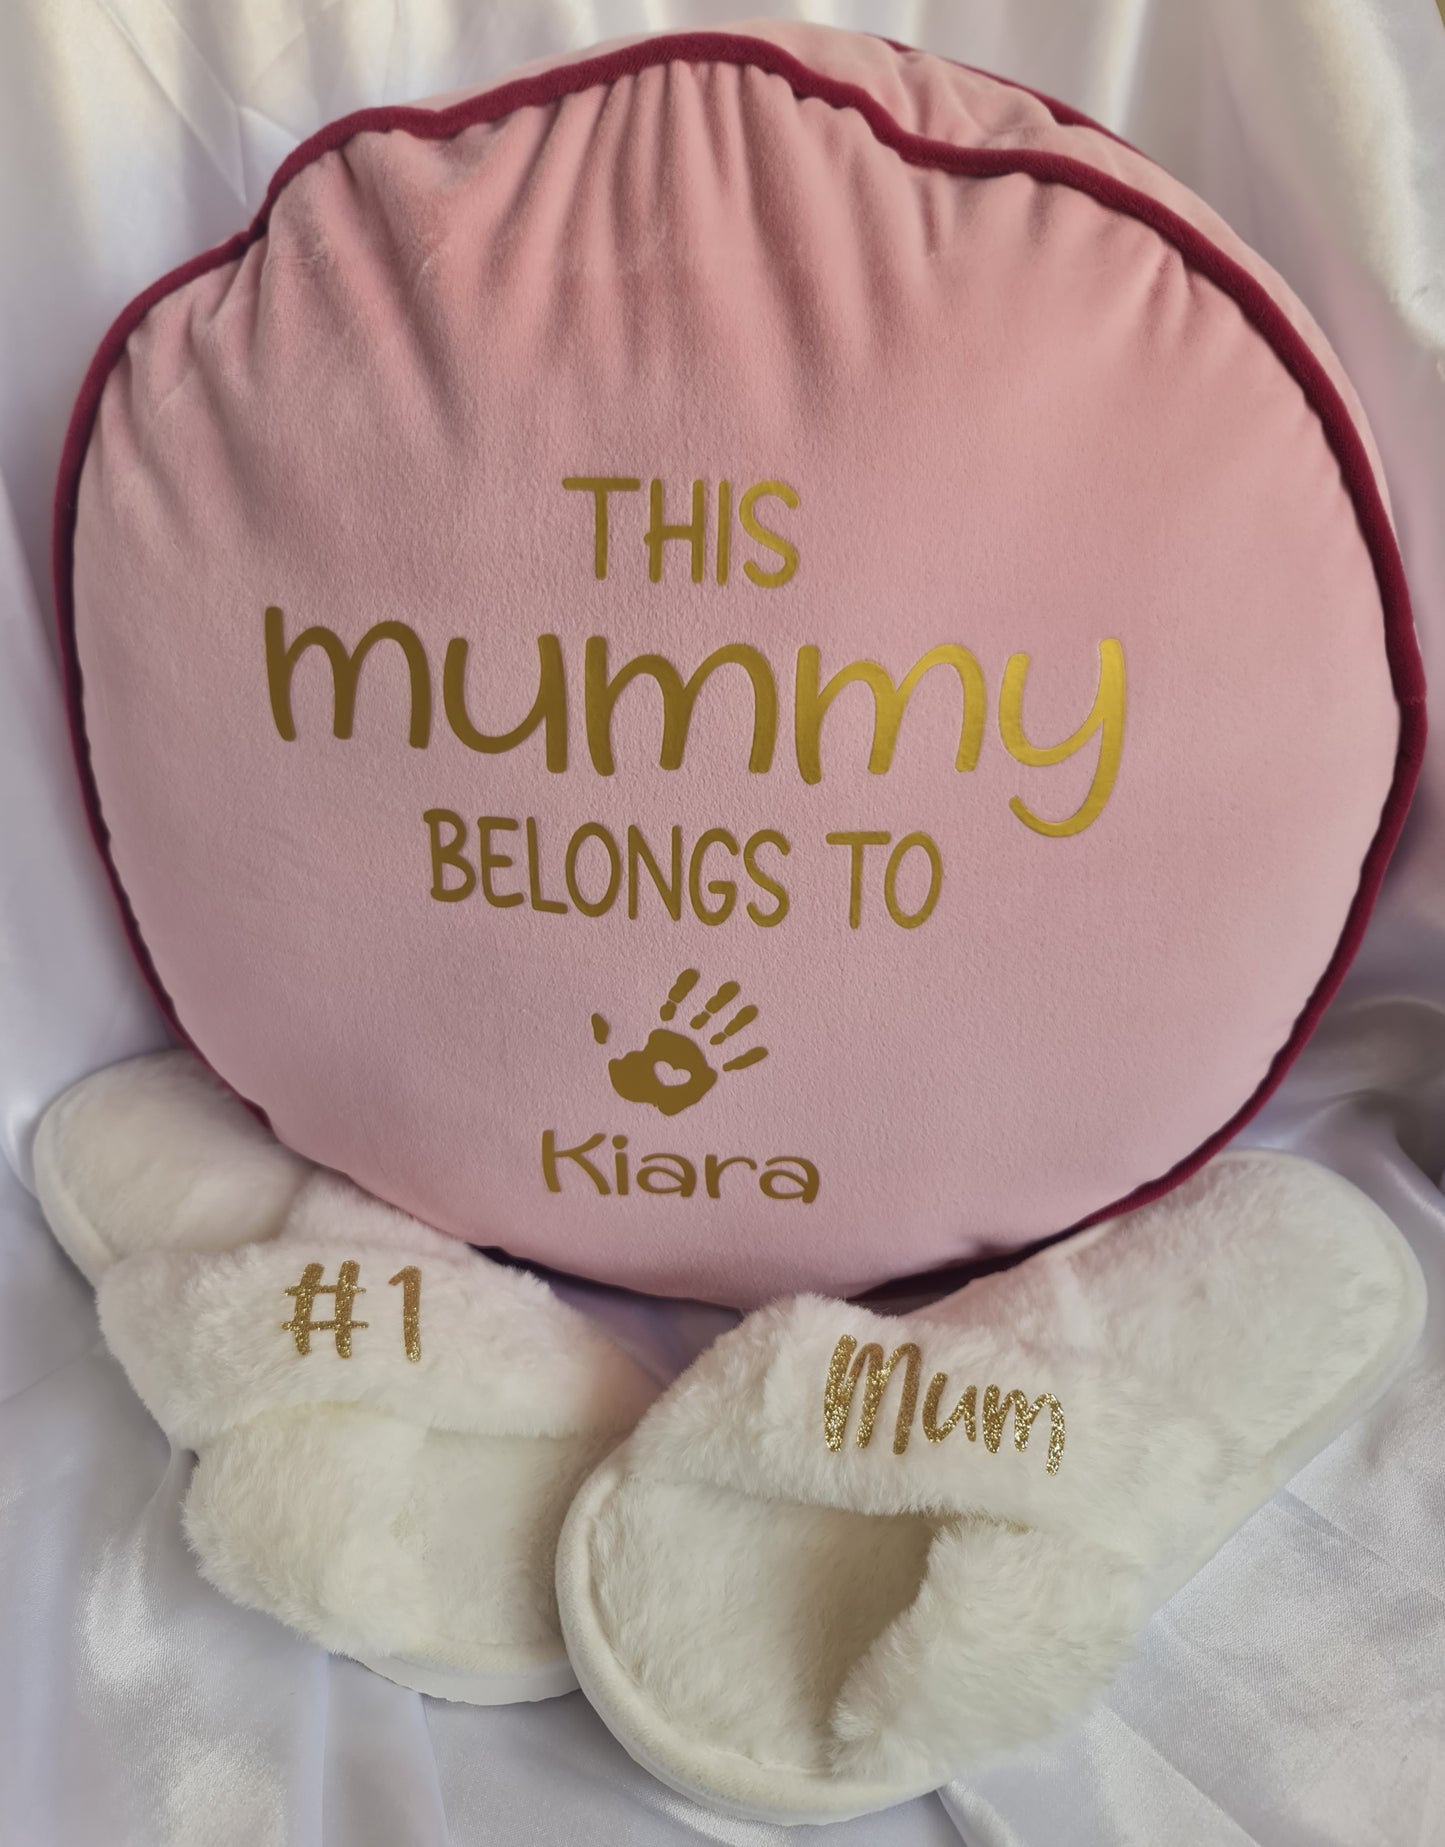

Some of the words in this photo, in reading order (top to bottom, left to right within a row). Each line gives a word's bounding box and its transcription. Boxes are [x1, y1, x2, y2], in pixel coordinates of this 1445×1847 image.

[563, 475, 800, 588] THIS
[263, 605, 1127, 837] mummy
[422, 808, 791, 928] BELONGS
[827, 830, 944, 929] TO
[540, 1128, 821, 1204] Kiara
[281, 1260, 422, 1363] #1
[823, 1334, 1066, 1476] Mum
